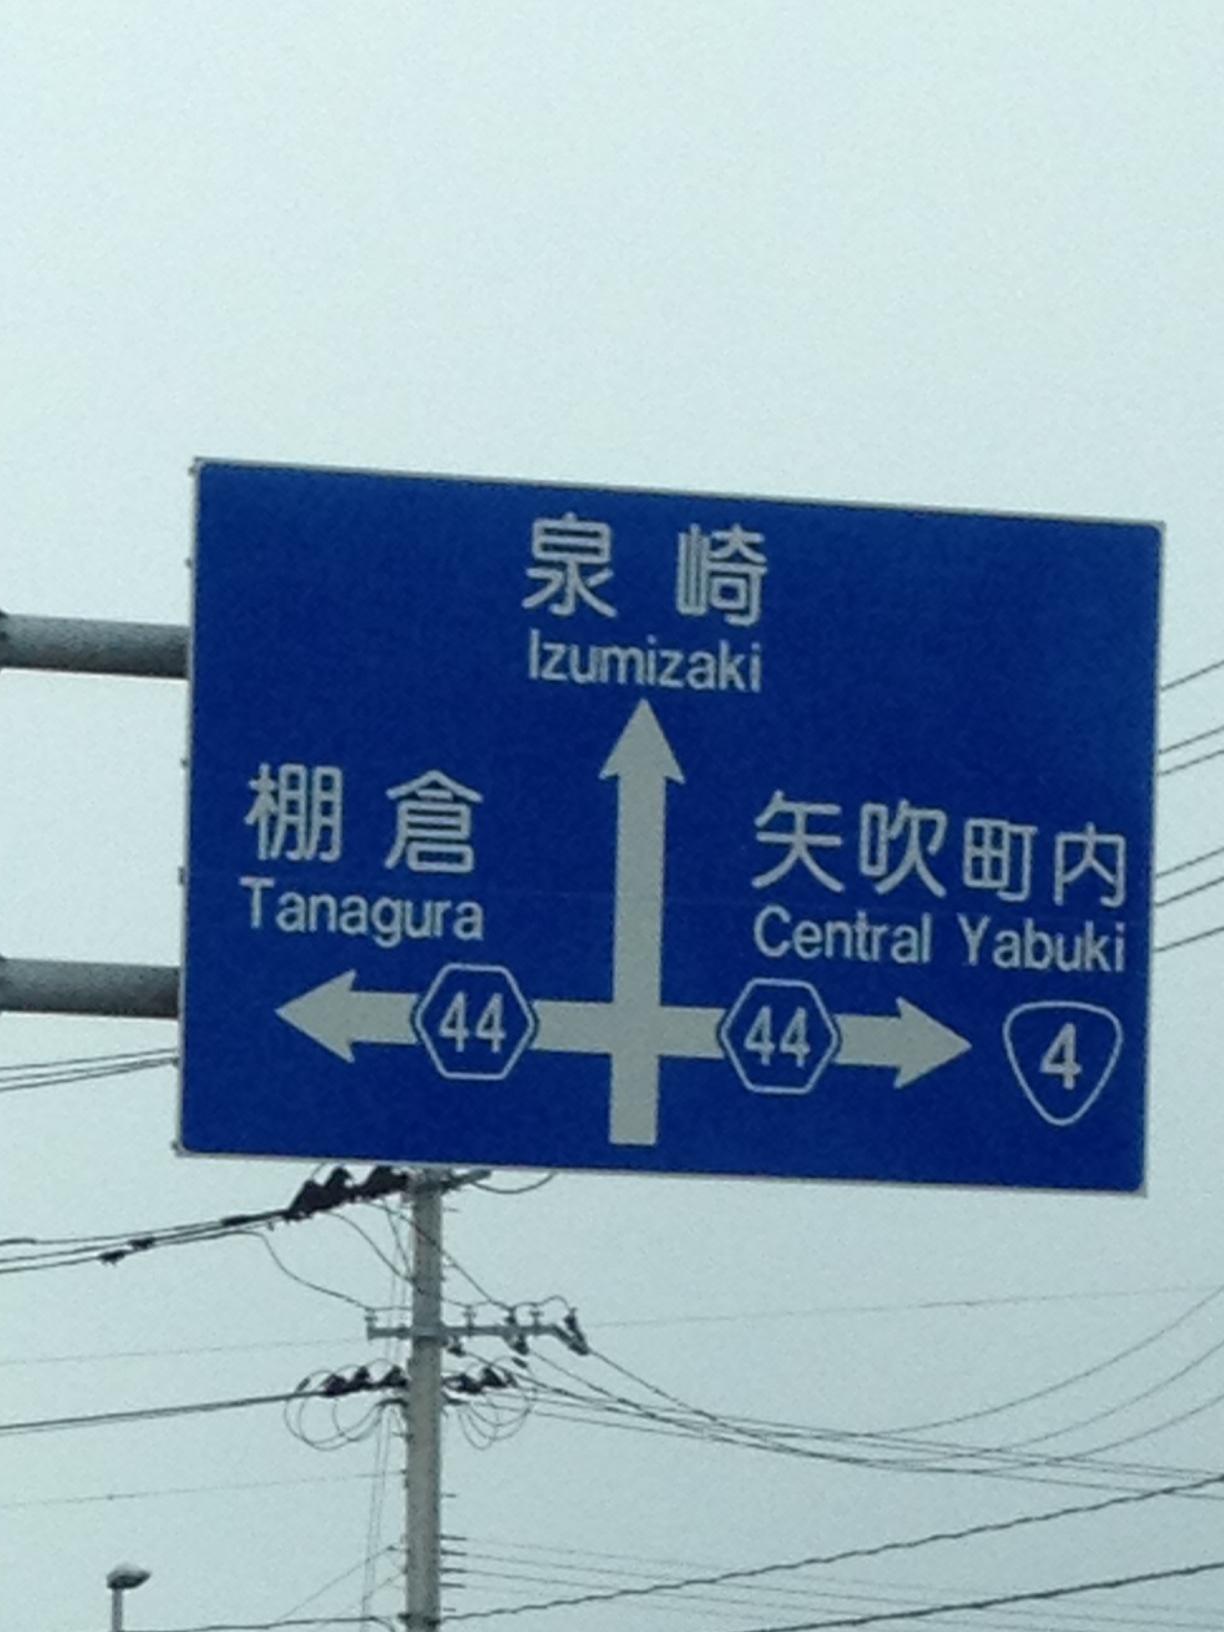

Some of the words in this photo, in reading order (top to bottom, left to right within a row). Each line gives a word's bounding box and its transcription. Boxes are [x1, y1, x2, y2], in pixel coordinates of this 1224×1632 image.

[521, 510, 768, 627] 泉崎
[527, 629, 763, 693] Izumizaki
[243, 762, 483, 876] 棚倉
[751, 791, 1128, 908] 矢吹町内
[239, 875, 484, 948] Tanagura
[753, 905, 933, 965] Central
[955, 912, 1128, 974] Yabuki
[436, 991, 508, 1054] 44
[742, 1005, 811, 1069] 44
[1039, 1021, 1082, 1090] 4
